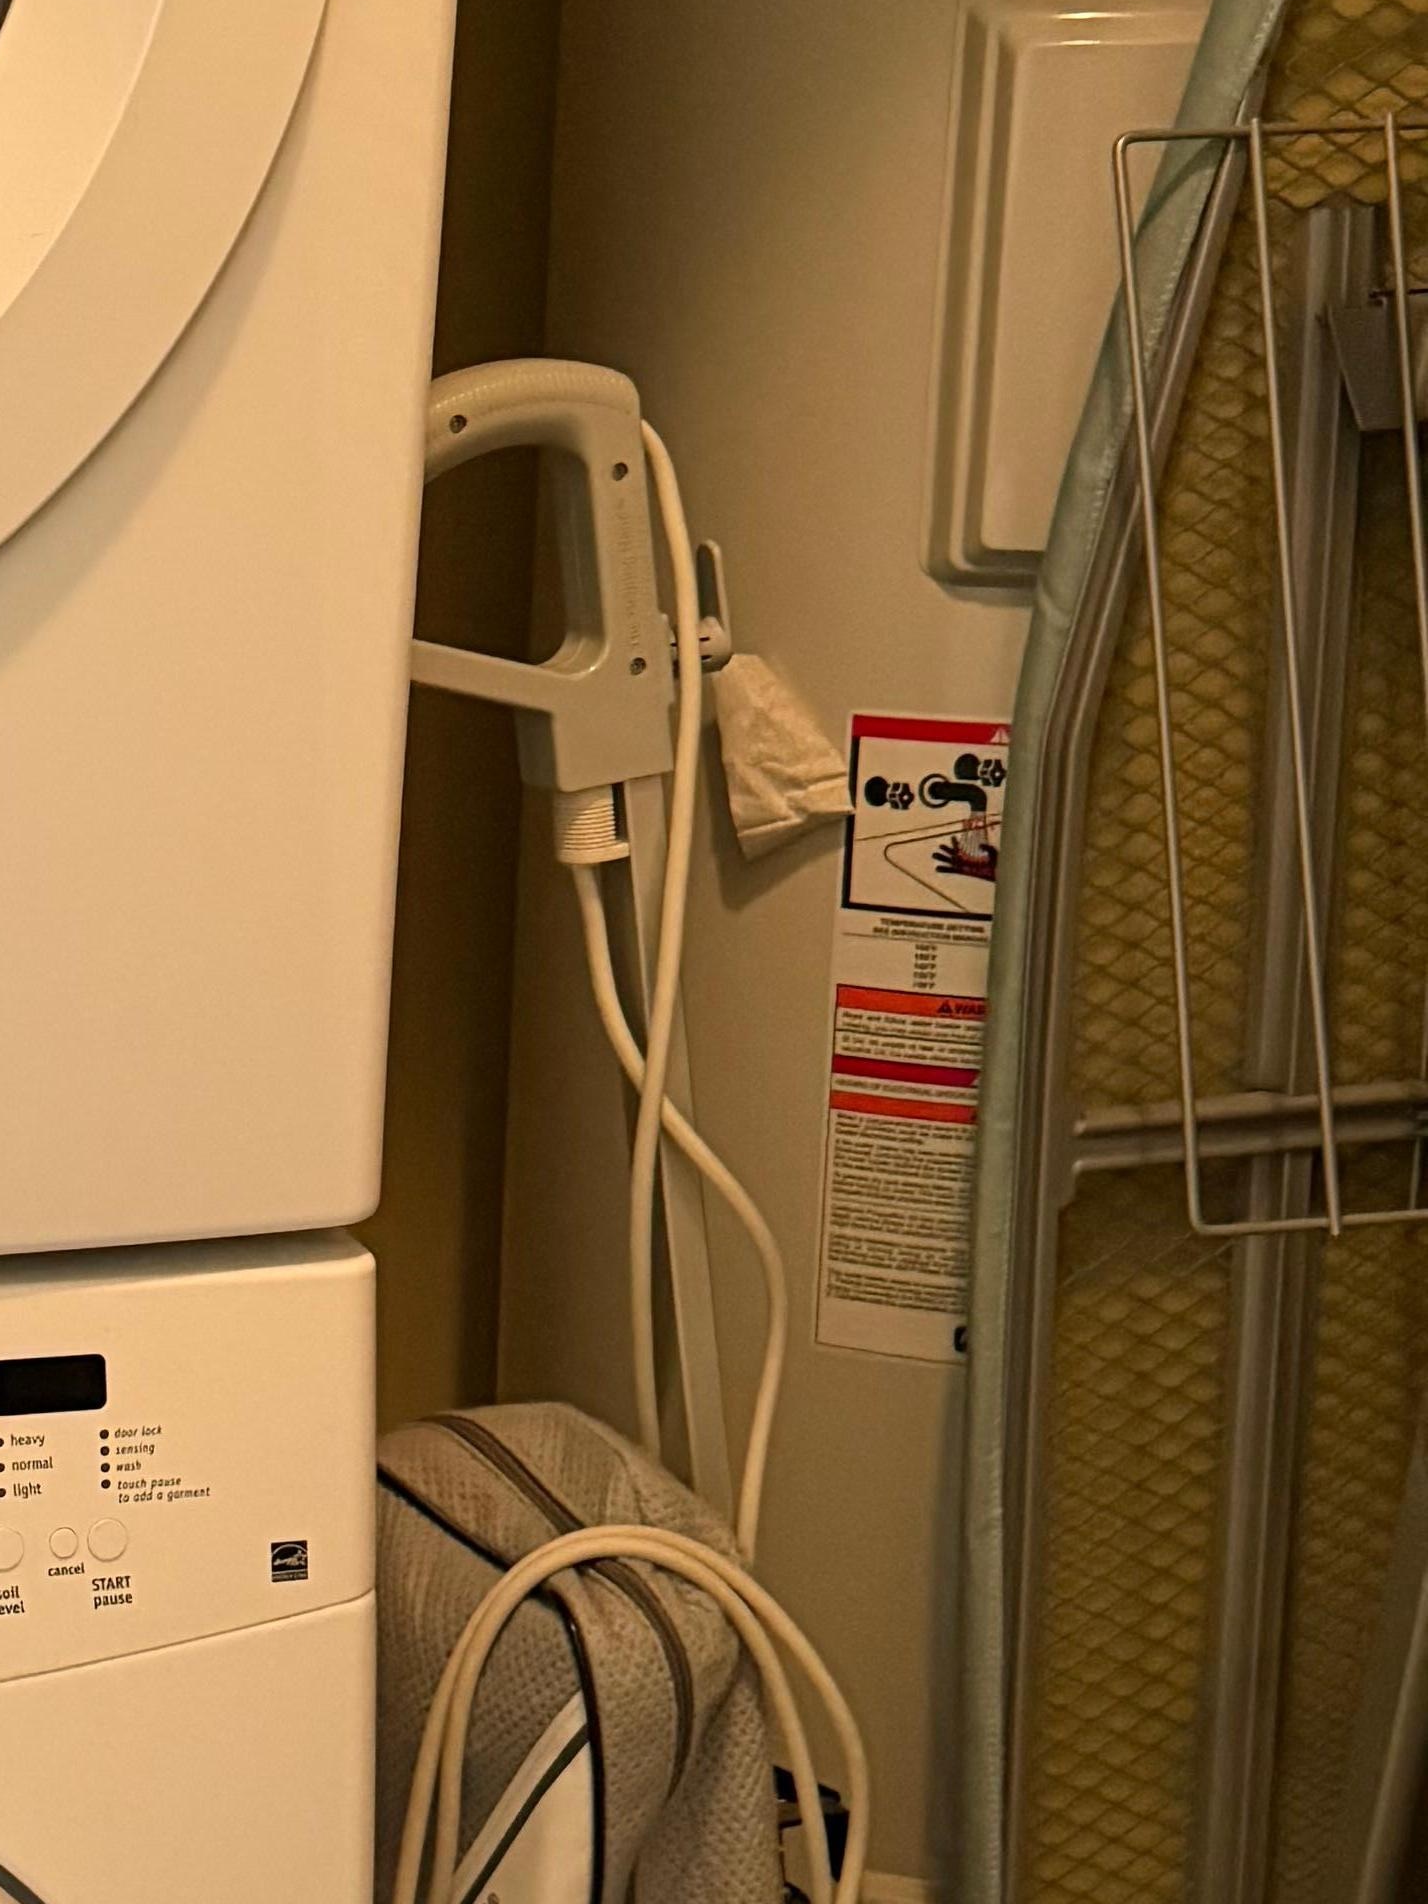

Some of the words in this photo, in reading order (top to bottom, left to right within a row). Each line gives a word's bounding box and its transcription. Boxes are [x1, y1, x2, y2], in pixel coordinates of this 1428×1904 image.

[113, 1426, 138, 1439] door
[141, 1424, 162, 1437] lock
[10, 1433, 45, 1448] heavy
[115, 1442, 155, 1456] sensing
[11, 1457, 54, 1472] normal
[116, 1460, 142, 1473] wash
[12, 1482, 42, 1499] light
[117, 1477, 147, 1491] touch
[150, 1476, 182, 1490] pause
[167, 1486, 210, 1503] garment
[47, 1562, 86, 1577] cancel
[91, 1575, 132, 1592] START
[93, 1592, 133, 1609] pause
